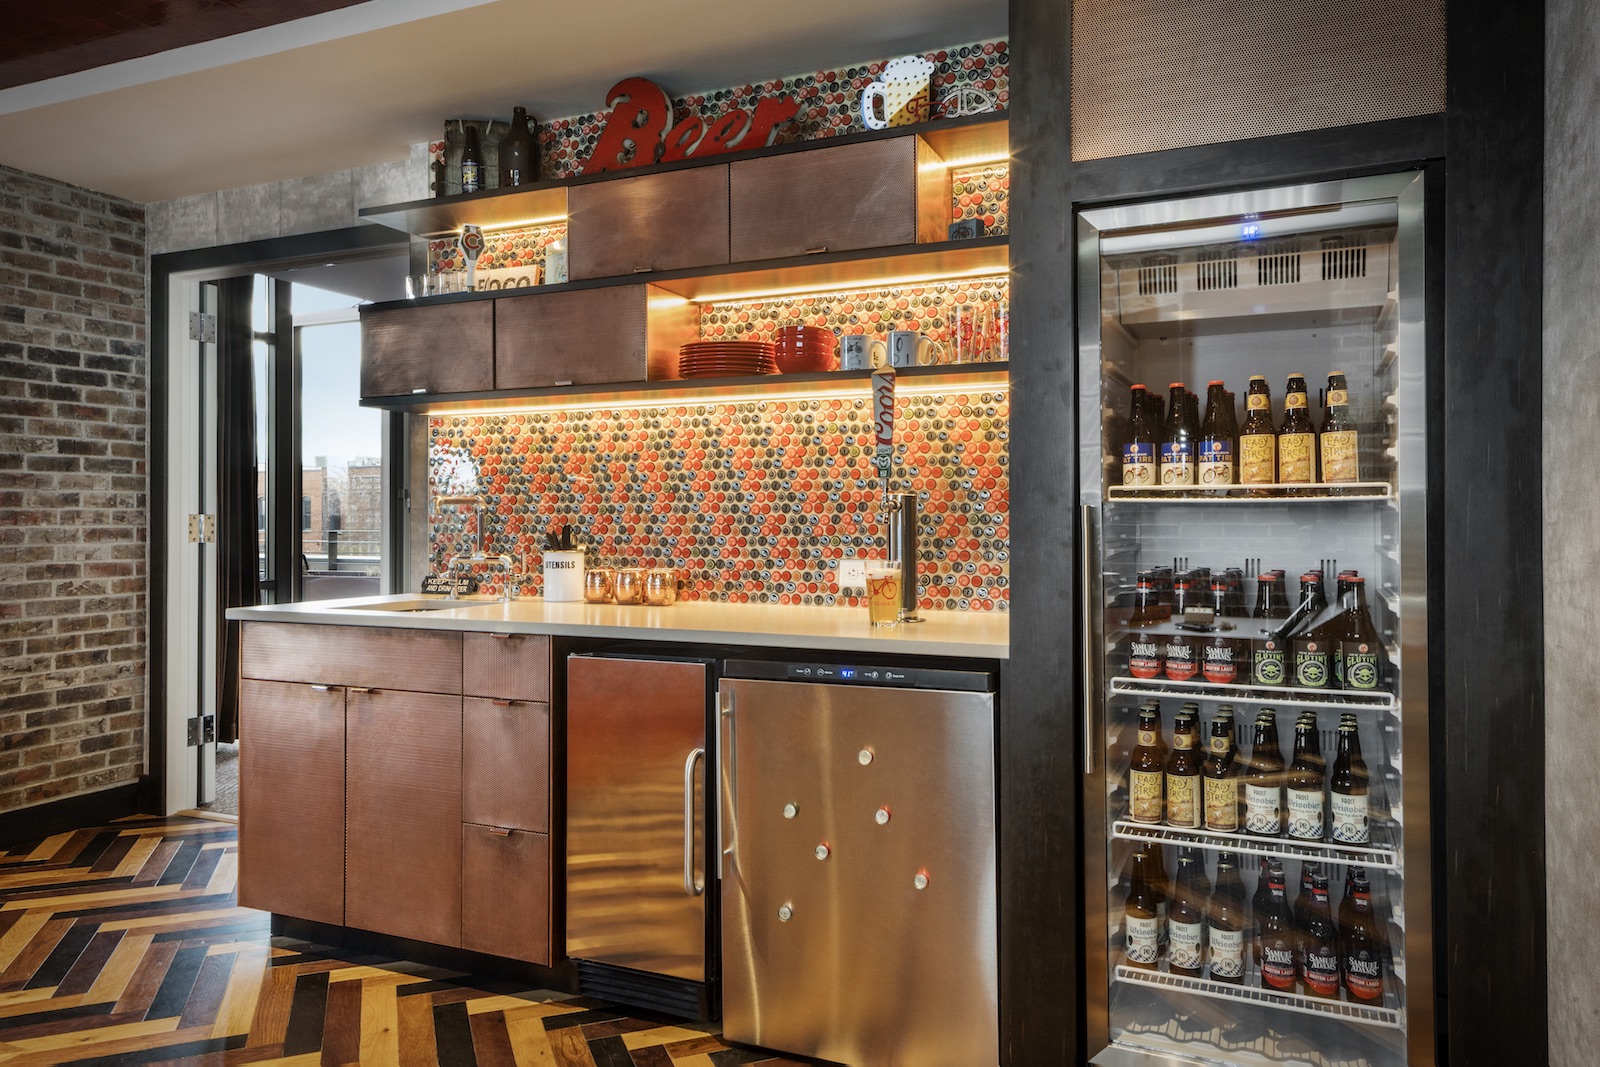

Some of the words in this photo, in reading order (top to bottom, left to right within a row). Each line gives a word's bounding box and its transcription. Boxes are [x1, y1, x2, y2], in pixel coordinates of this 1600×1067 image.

[581, 77, 801, 175] Beer
[1245, 436, 1268, 448] EASY
[1281, 434, 1304, 448] EASY
[1326, 432, 1351, 446] EASY
[545, 561, 576, 569] UTENSILS
[1131, 642, 1158, 652] SAMUEL
[1166, 643, 1192, 654] SAMUEL
[1205, 646, 1233, 655] SAMUEL
[1132, 649, 1156, 657] ADAMS
[1167, 651, 1190, 660] ADAMS
[1207, 653, 1231, 661] ADAMS
[1255, 653, 1285, 663] GLUTINY
[1296, 655, 1328, 665] GLUTINY
[1346, 656, 1377, 667] GLUTINY
[1167, 788, 1192, 800] TREET
[1264, 947, 1293, 958] SAMUEL
[1266, 955, 1292, 965] ADAMS
[1309, 953, 1338, 964] SAMUEL
[1348, 956, 1379, 969] SAMUEL
[1311, 961, 1337, 971] ADAMS
[1350, 965, 1377, 976] ADAMS
